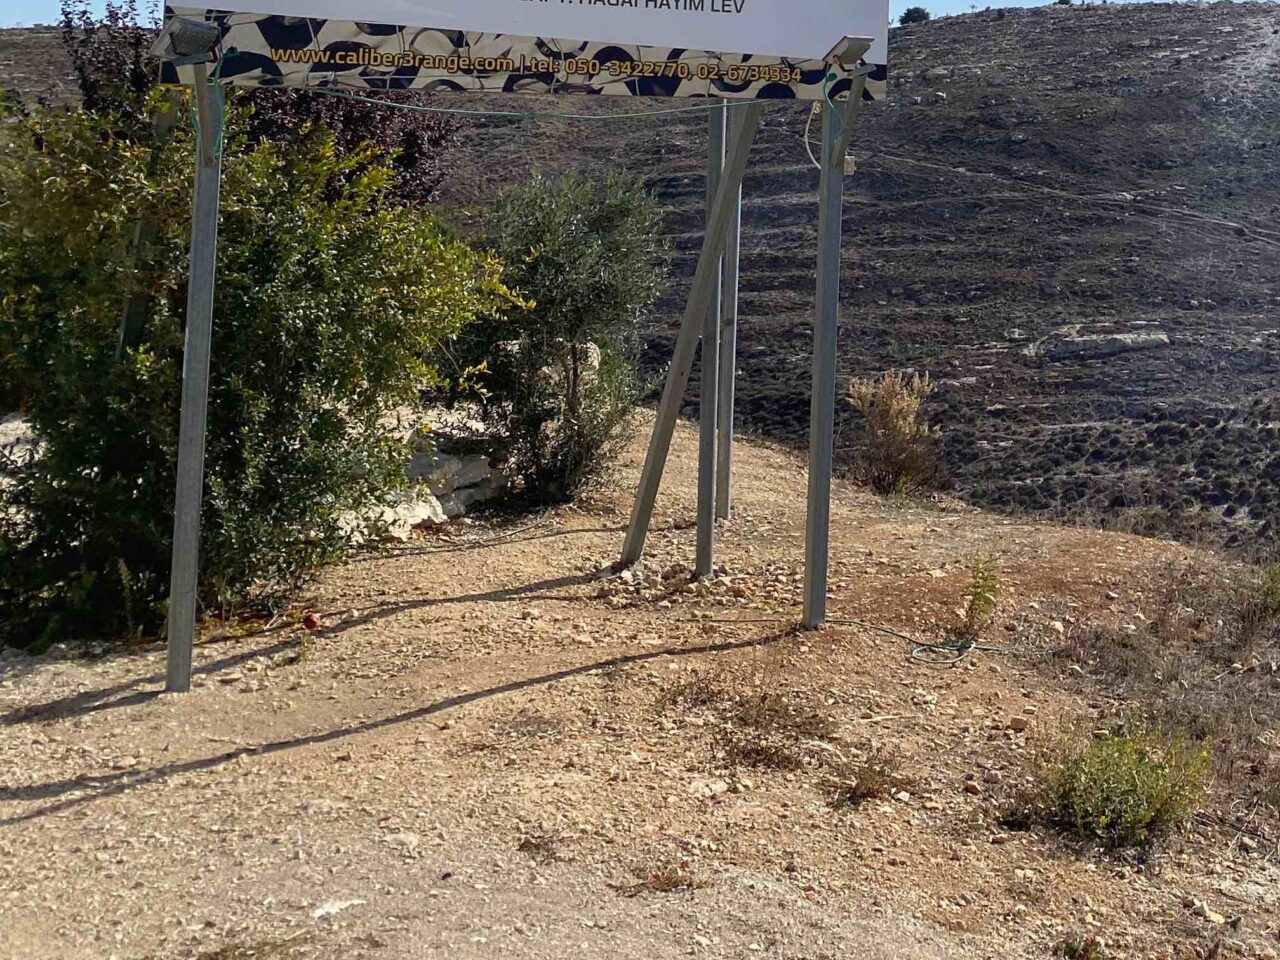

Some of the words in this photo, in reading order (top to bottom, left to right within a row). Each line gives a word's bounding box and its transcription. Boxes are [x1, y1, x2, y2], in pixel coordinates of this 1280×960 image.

[270, 48, 513, 72] www.caliber3range.com
[530, 57, 560, 73] tel:
[565, 58, 692, 81] 050-3422770,
[697, 64, 802, 82] 02-6734334
